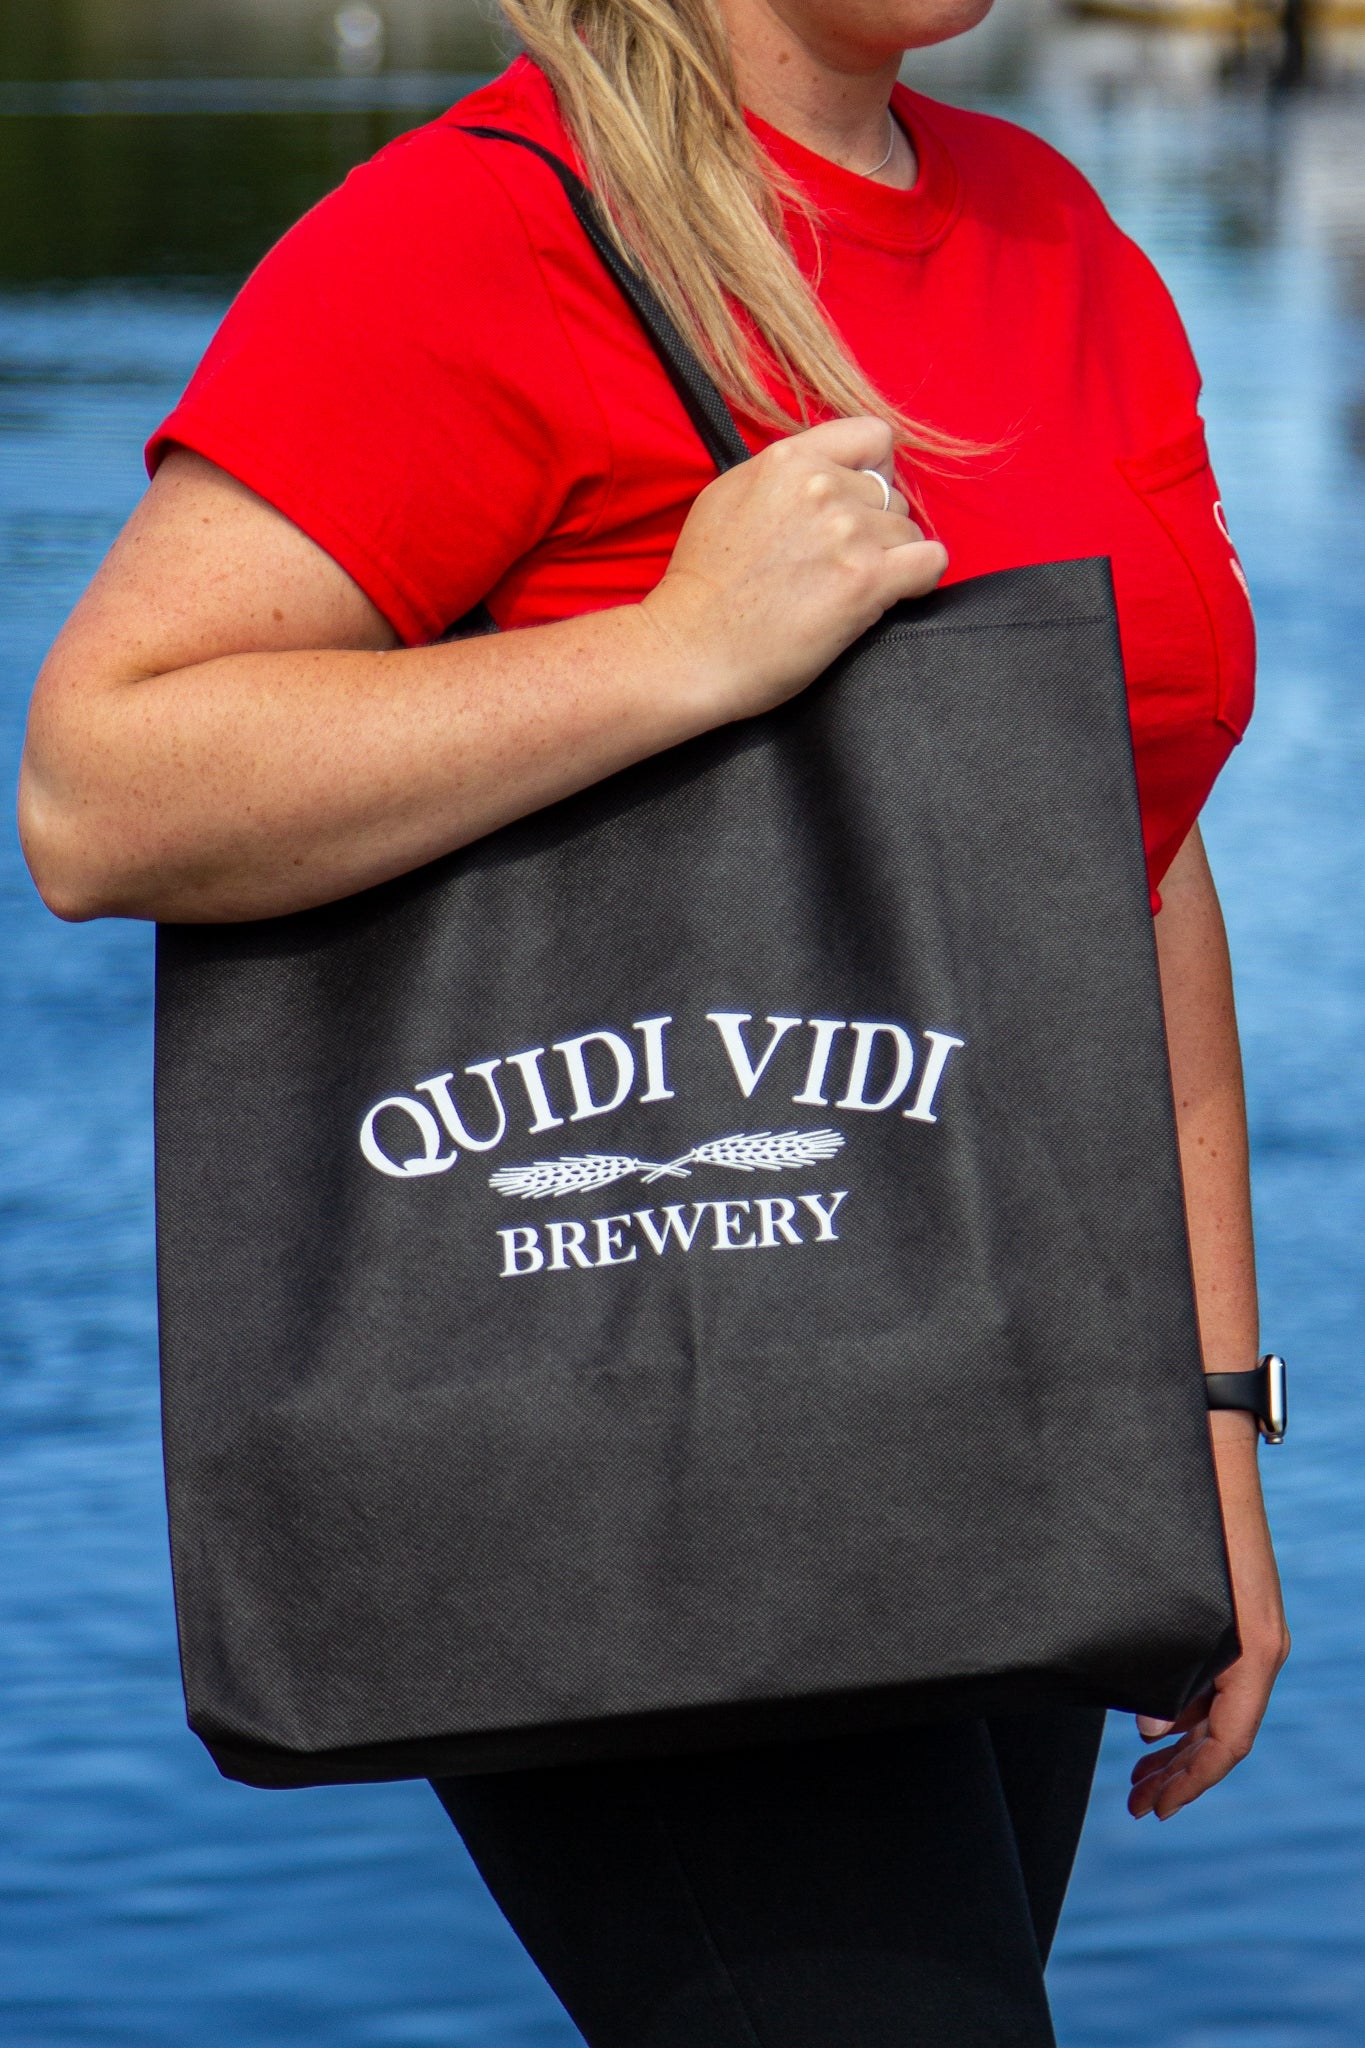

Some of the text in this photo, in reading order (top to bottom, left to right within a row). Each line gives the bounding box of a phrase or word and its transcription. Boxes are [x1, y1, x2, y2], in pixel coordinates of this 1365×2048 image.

[359, 1012, 966, 1179] QUIDI VIDI
[496, 1190, 849, 1278] BREWERY
